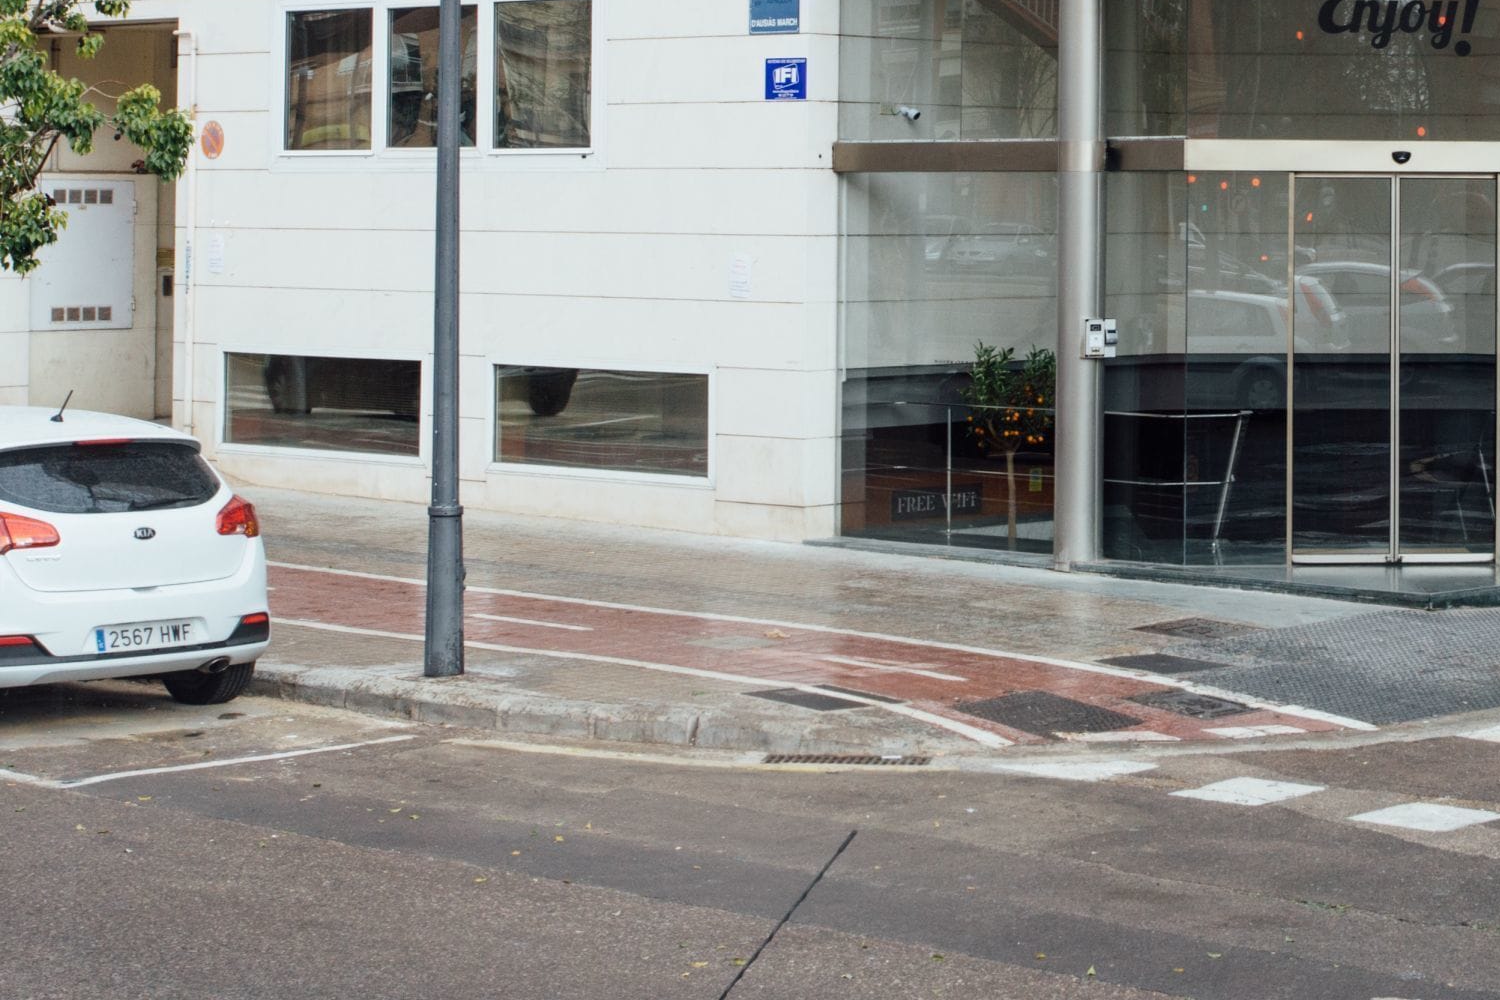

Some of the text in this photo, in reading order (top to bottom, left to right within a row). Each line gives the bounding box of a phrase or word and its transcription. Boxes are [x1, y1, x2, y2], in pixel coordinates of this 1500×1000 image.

[777, 17, 798, 27] MARCH
[775, 67, 797, 84] IFI
[897, 494, 936, 514] FREE
[136, 528, 155, 539] KIA
[109, 623, 191, 649] 2567 HWF
